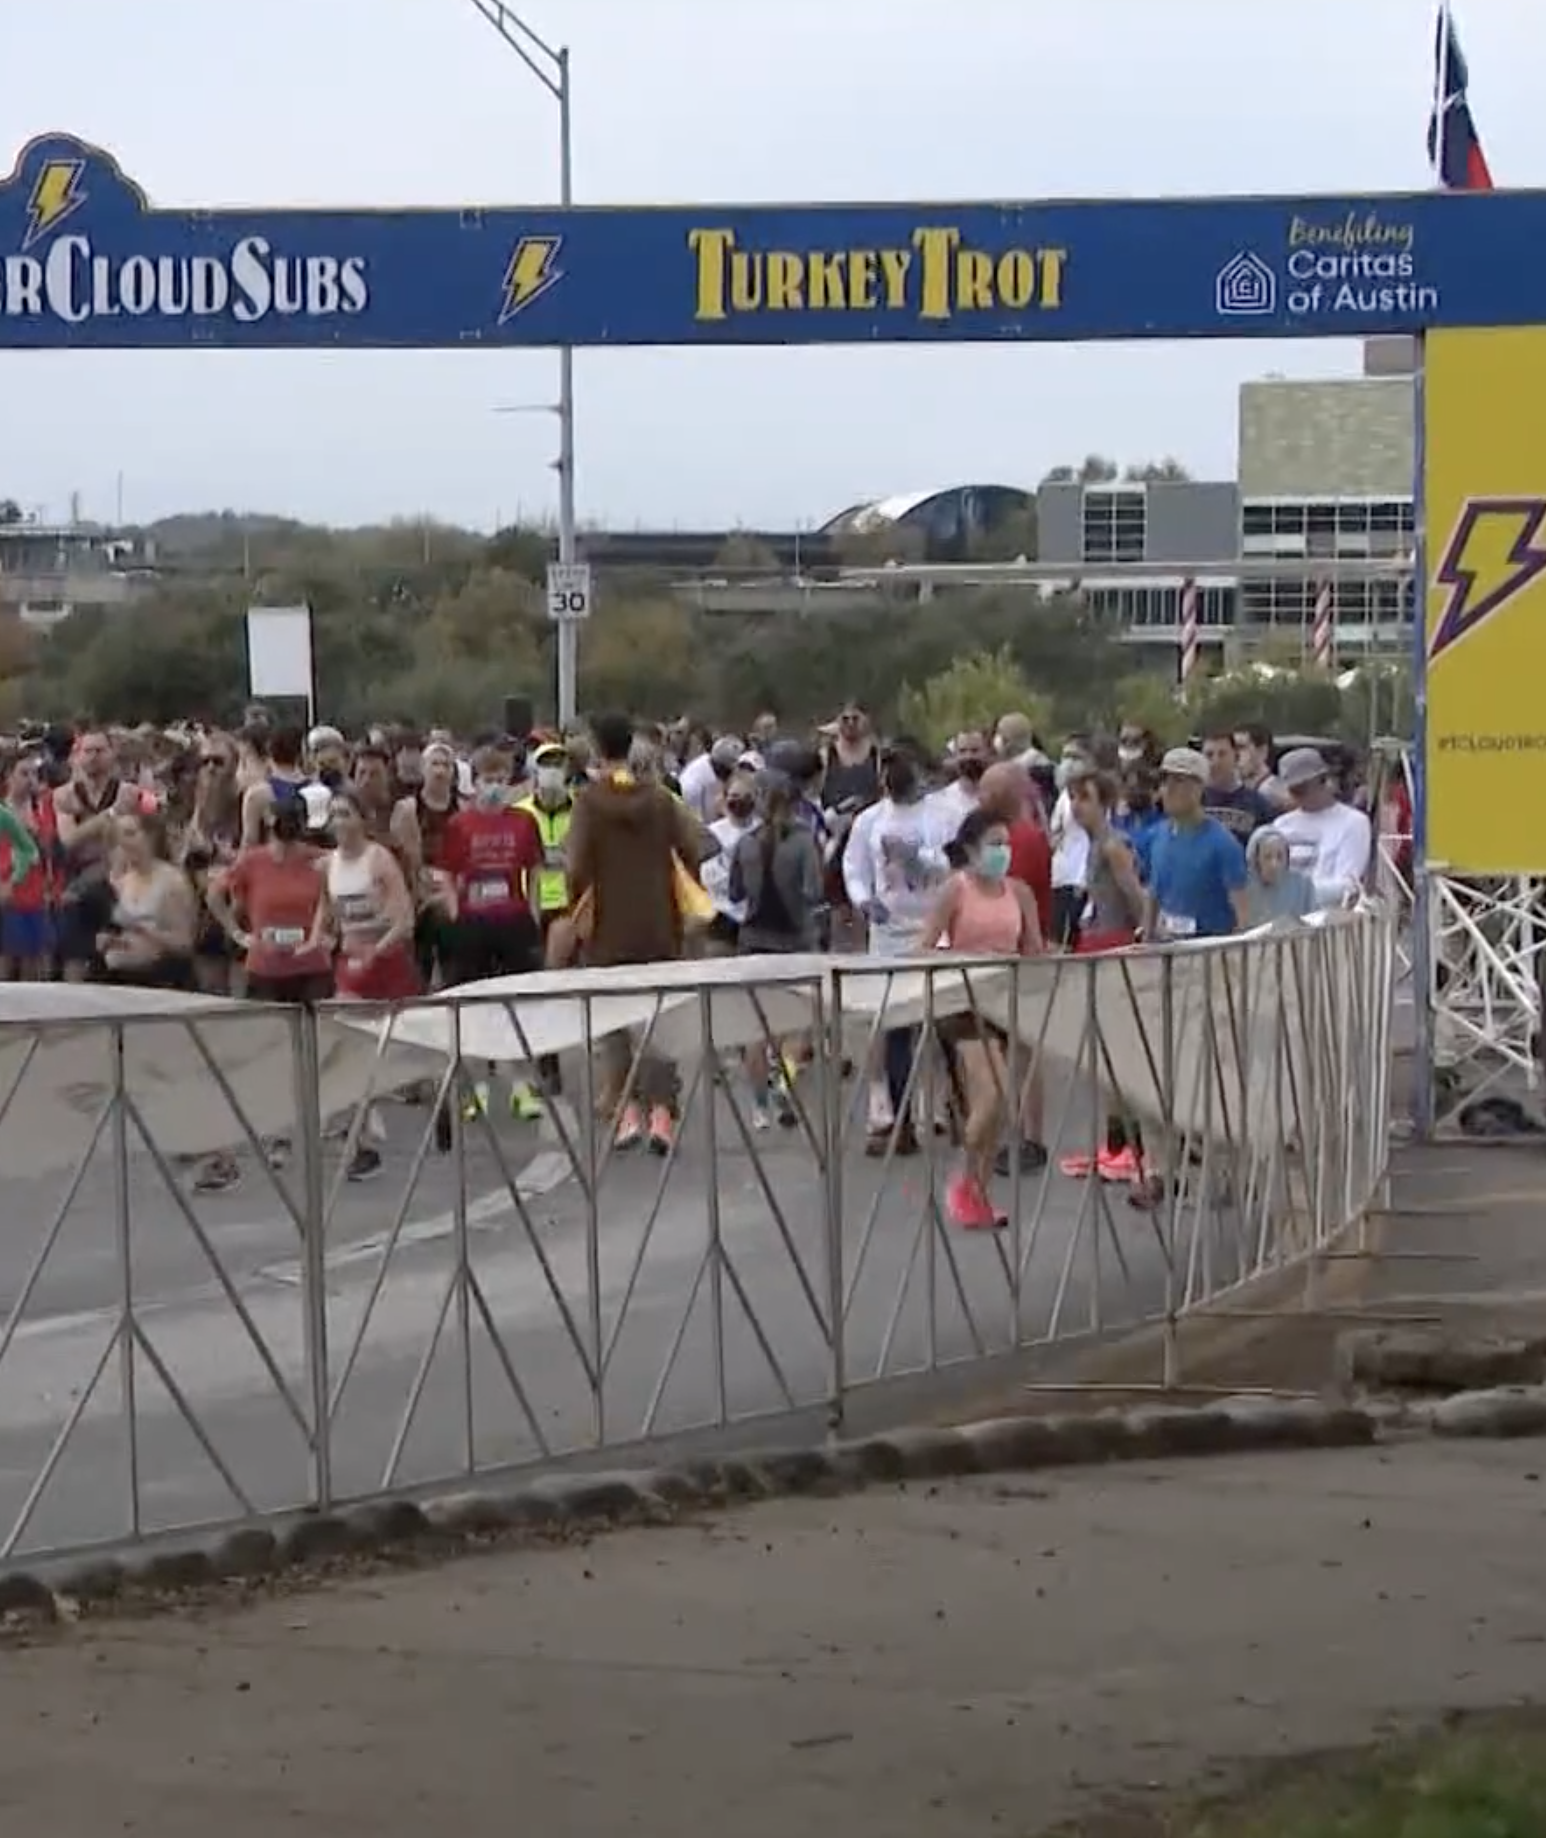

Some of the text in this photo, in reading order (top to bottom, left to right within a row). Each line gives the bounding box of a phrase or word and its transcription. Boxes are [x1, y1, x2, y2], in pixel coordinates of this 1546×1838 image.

[1288, 249, 1414, 279] Caritas
[1288, 282, 1438, 312] of Austin
[552, 592, 585, 612] 30
